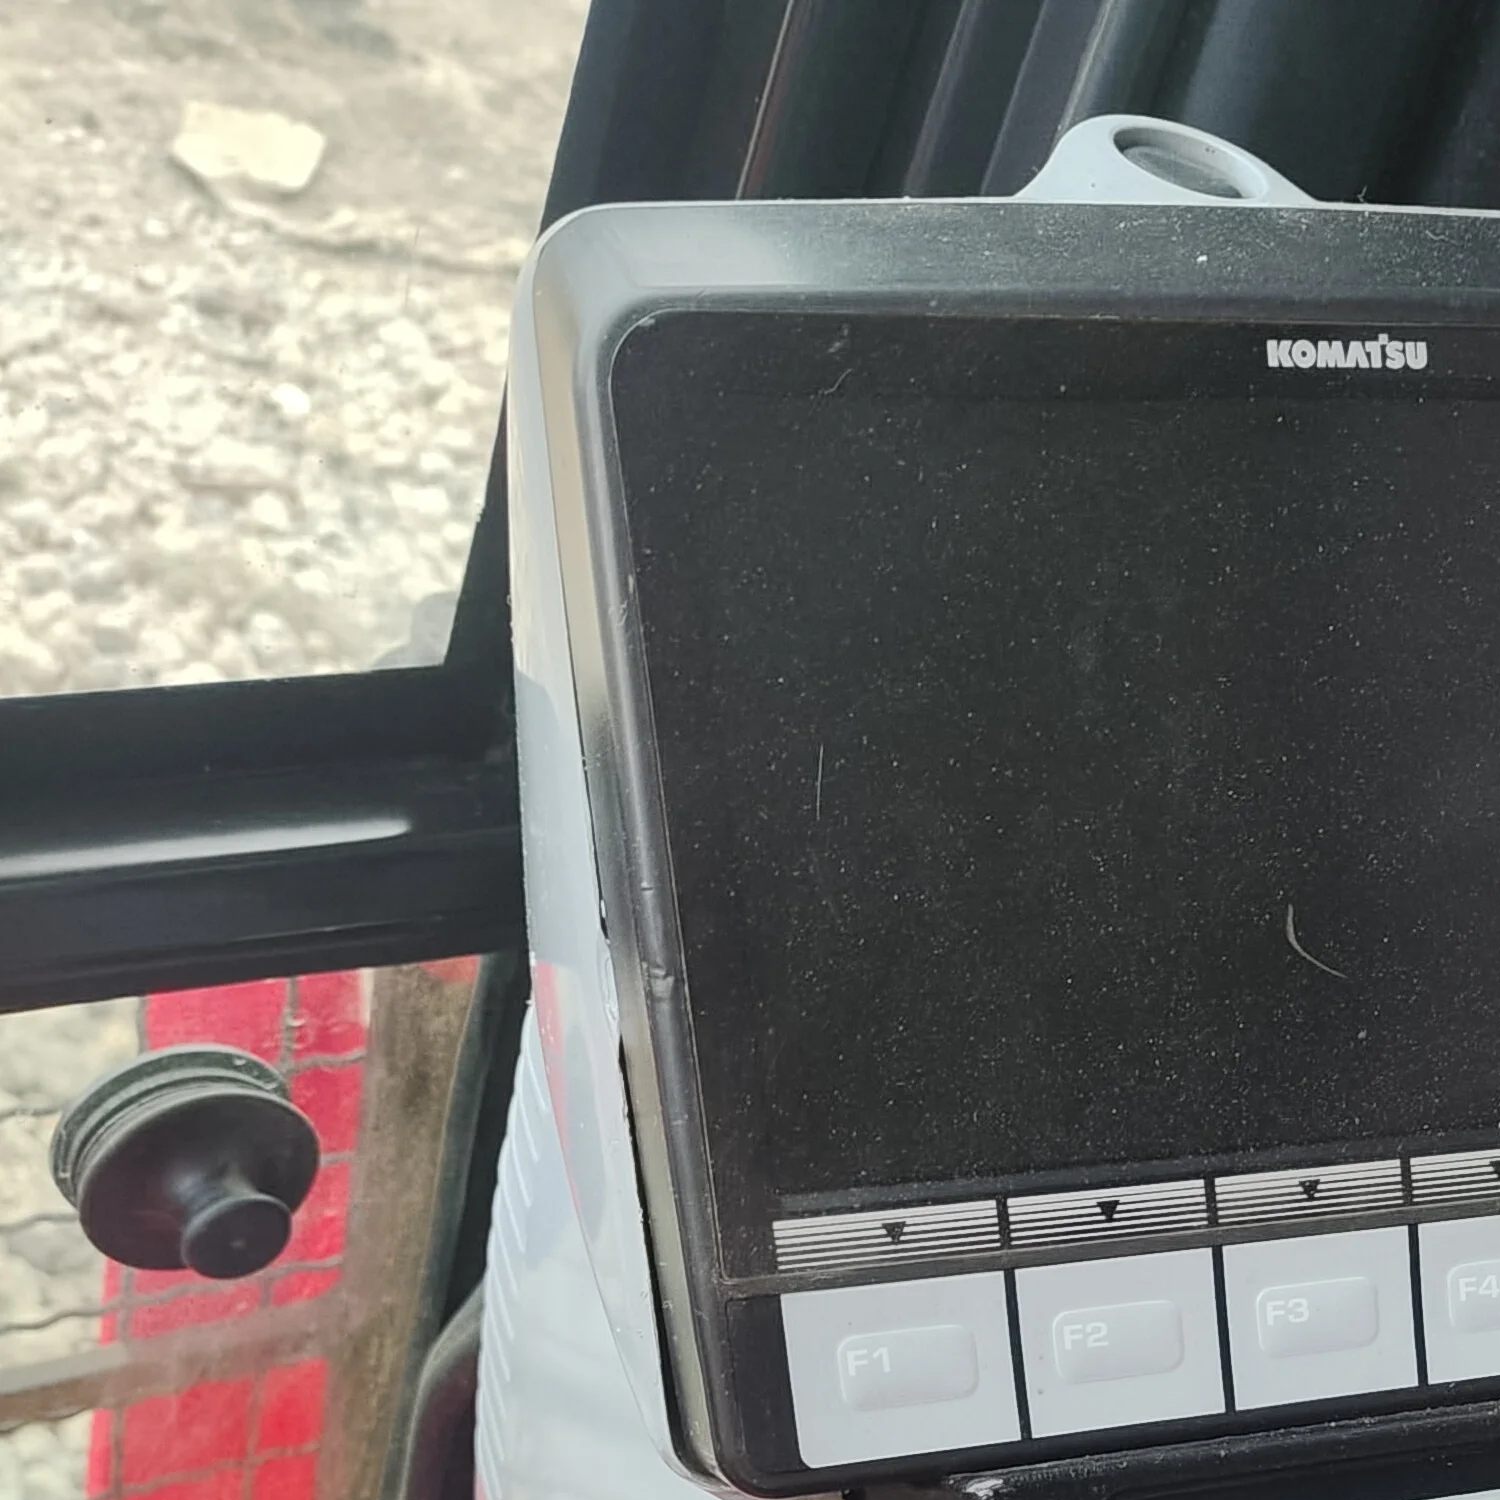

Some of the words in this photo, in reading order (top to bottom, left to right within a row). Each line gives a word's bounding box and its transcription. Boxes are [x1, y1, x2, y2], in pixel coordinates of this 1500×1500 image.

[1267, 333, 1428, 370] KOMATSU
[1458, 1275, 1500, 1302] F4
[1266, 1298, 1310, 1326] F3
[1063, 1322, 1109, 1351] F2
[846, 1347, 892, 1377] F1
